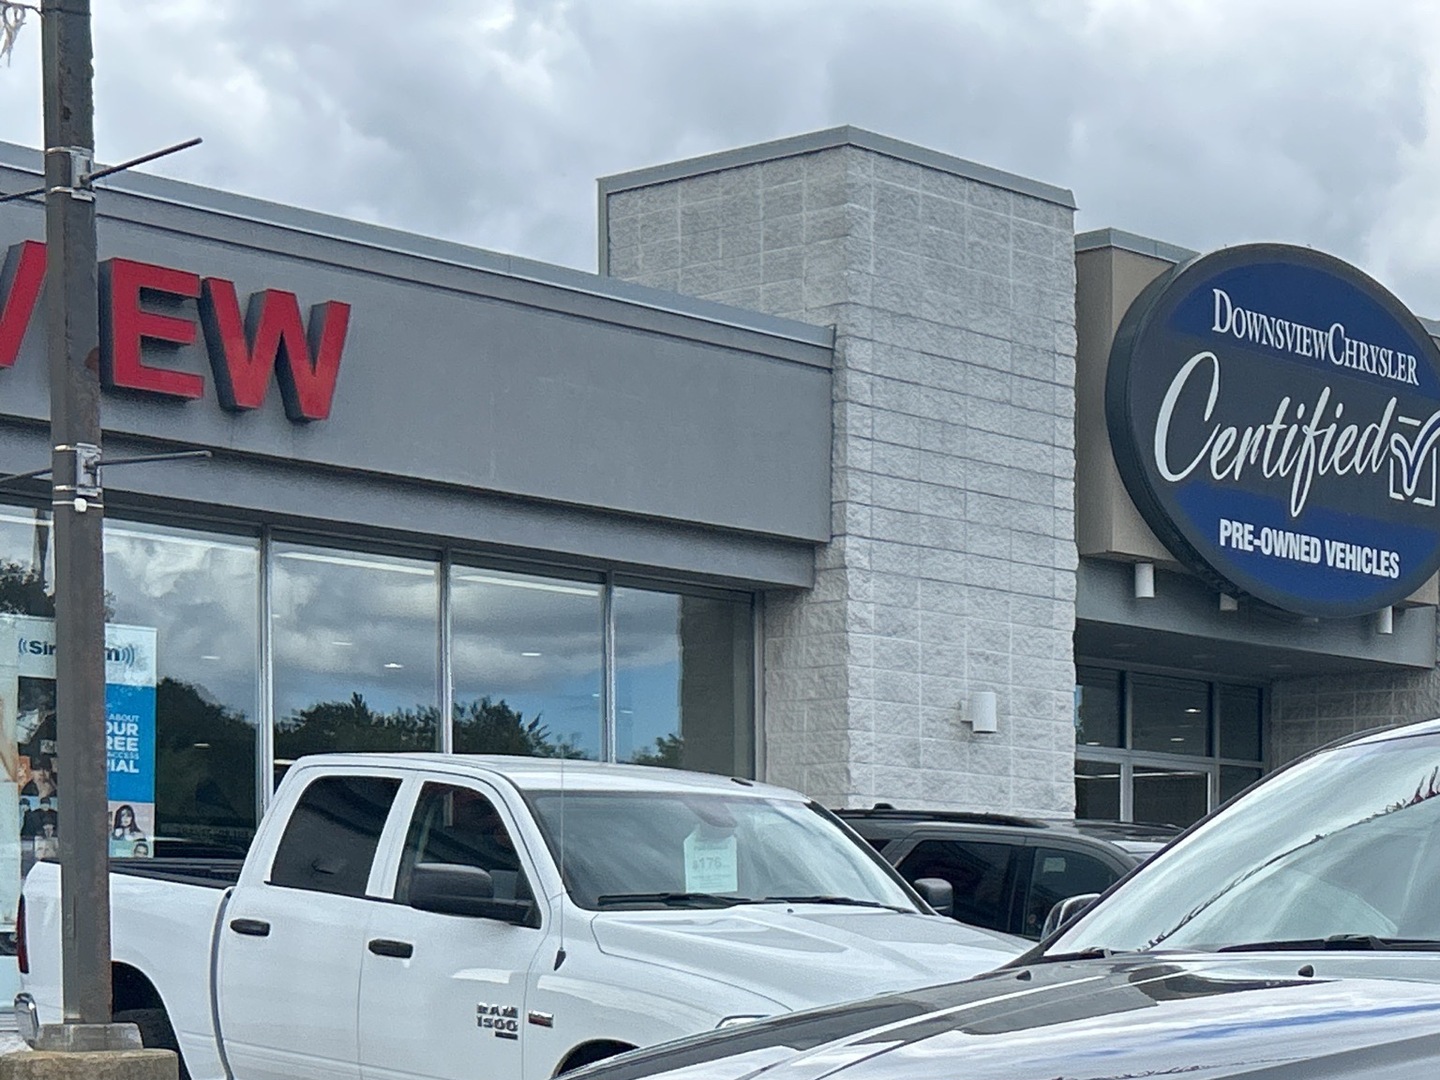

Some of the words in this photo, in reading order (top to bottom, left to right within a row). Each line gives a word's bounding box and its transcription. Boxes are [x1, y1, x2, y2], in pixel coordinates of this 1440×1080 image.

[1154, 351, 1397, 517] Certified
[1219, 518, 1321, 564] PRE-OWNED
[1324, 539, 1400, 579] VEHICLES
[106, 735, 139, 752] REE
[476, 1016, 518, 1032] 1500
